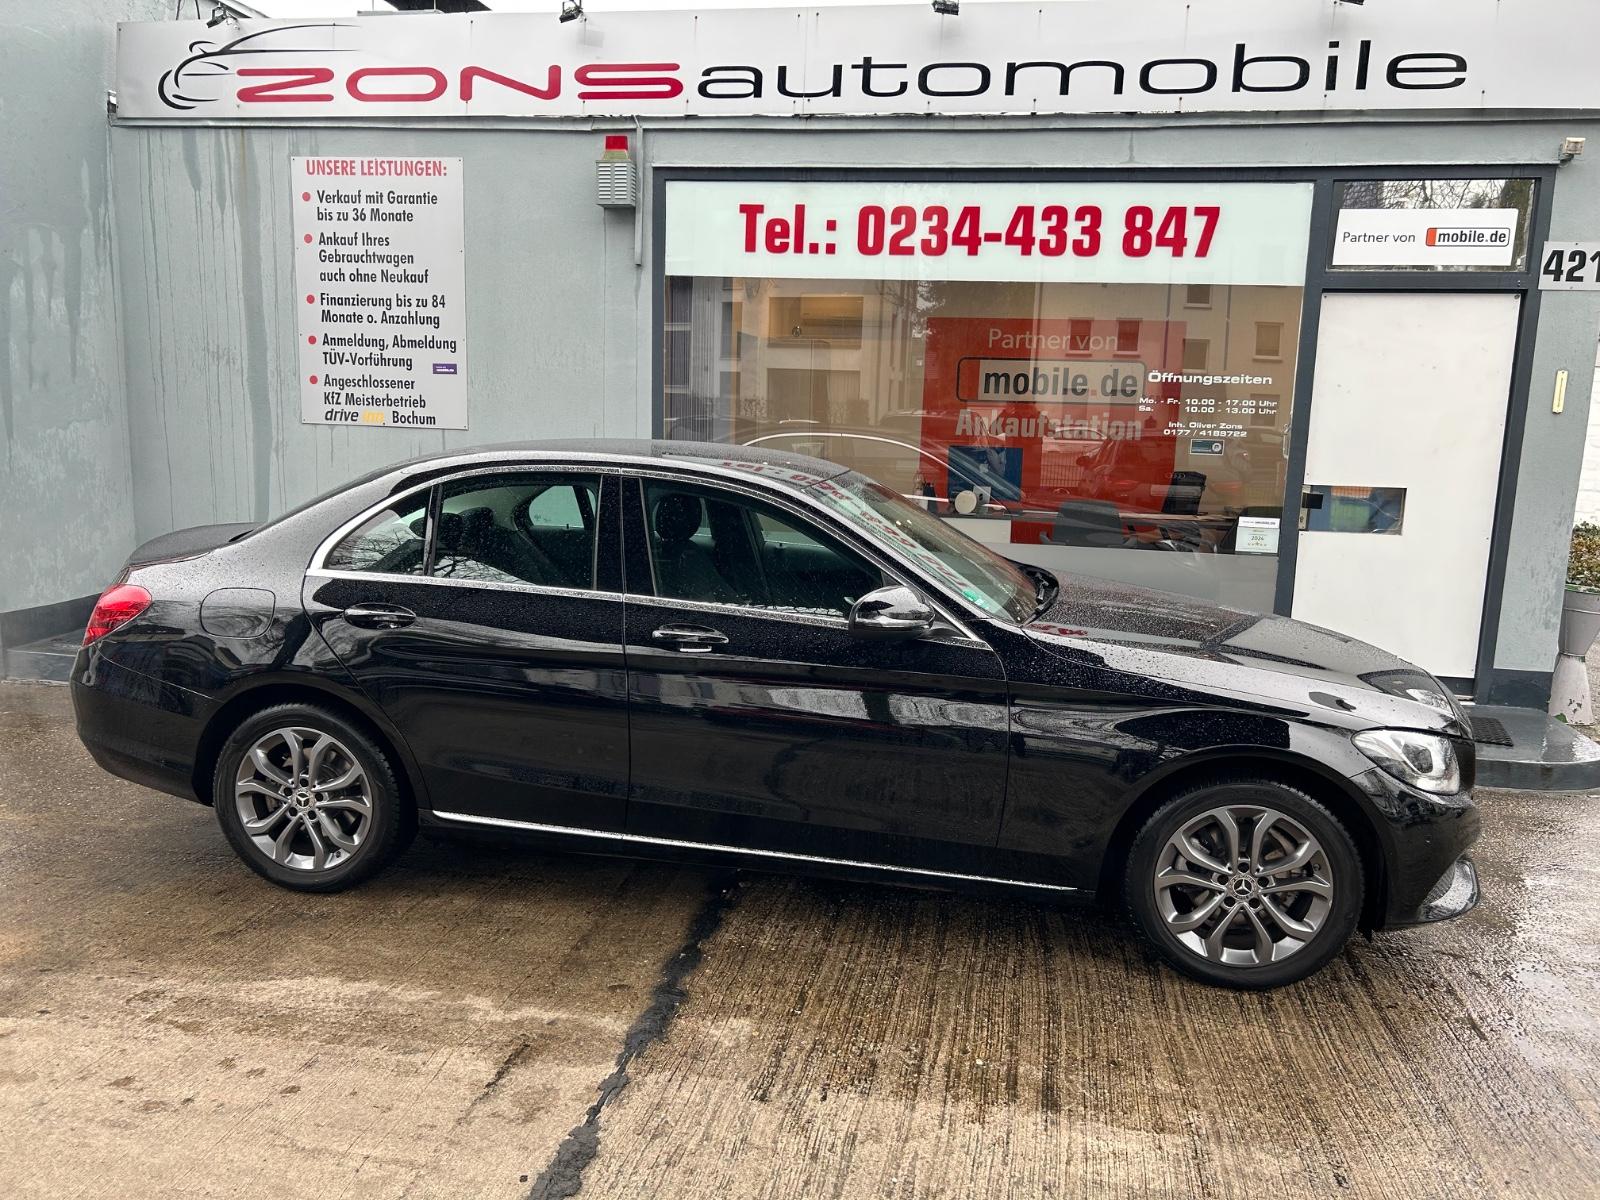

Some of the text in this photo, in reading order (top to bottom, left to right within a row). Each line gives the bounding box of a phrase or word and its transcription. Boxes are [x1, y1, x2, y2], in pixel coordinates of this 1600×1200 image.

[306, 160, 447, 176] UNSERE LEISTUNGEN:
[317, 190, 438, 204] Verkauf mit Garantie
[317, 207, 413, 221] bis zu 36 Monate
[319, 232, 390, 246] Ankauf Ihres
[739, 204, 1220, 258] Tel.: 0234-433 847
[1343, 230, 1507, 243] Partner von mobile.de
[319, 249, 414, 267] Gebrauchtwagen
[1543, 249, 1600, 283] 421
[320, 268, 428, 283] auch ohne Neukauf
[320, 293, 445, 310] Finanzierung bis zu 84
[321, 310, 440, 328] Monate o. Anzahlung
[322, 333, 457, 353] Anmeldung, Abmeldung
[988, 328, 1118, 350] Partner von
[323, 349, 412, 371] TÜV-Vorführung
[324, 374, 415, 390] Angeschlossener
[983, 368, 1137, 397] mobile.de
[1148, 370, 1272, 385] Öffnungszeiten
[324, 392, 426, 408] KfZ Meisterbetrieb
[325, 409, 358, 421] drive
[392, 411, 436, 425] Bochum
[955, 409, 1141, 440] Ankaufstation
